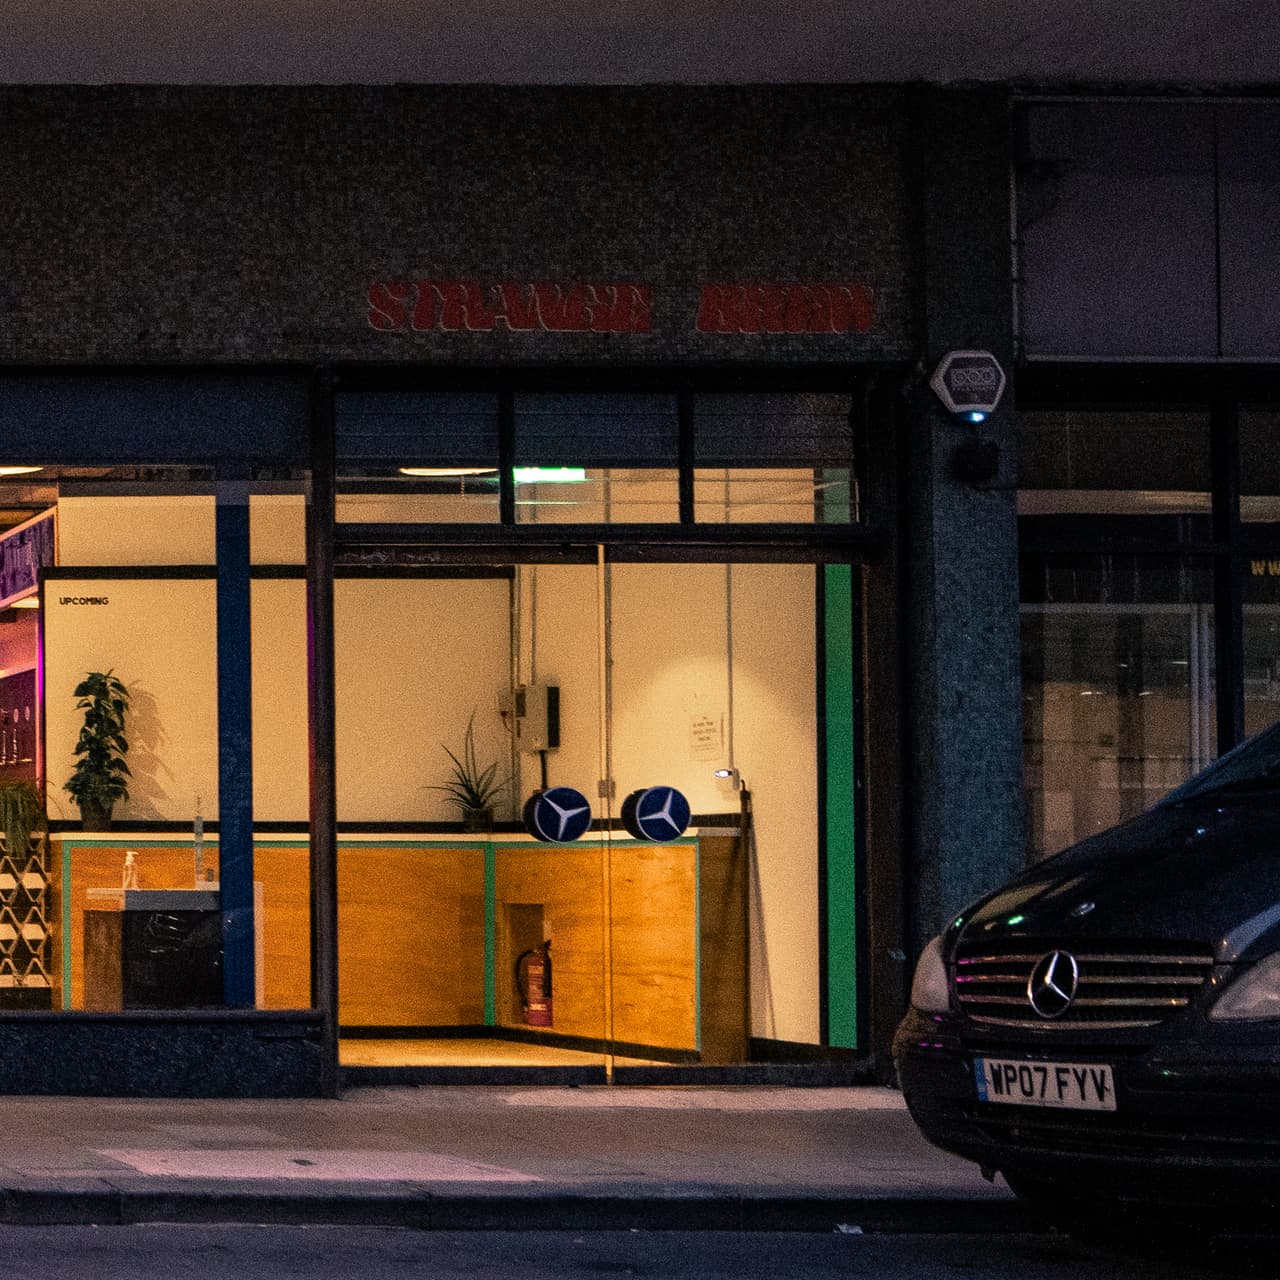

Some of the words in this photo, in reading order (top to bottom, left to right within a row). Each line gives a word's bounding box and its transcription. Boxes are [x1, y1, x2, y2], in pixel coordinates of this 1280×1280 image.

[58, 596, 110, 606] UPCOMING
[989, 1063, 1048, 1099] WP07
[1054, 1067, 1106, 1102] FYV
